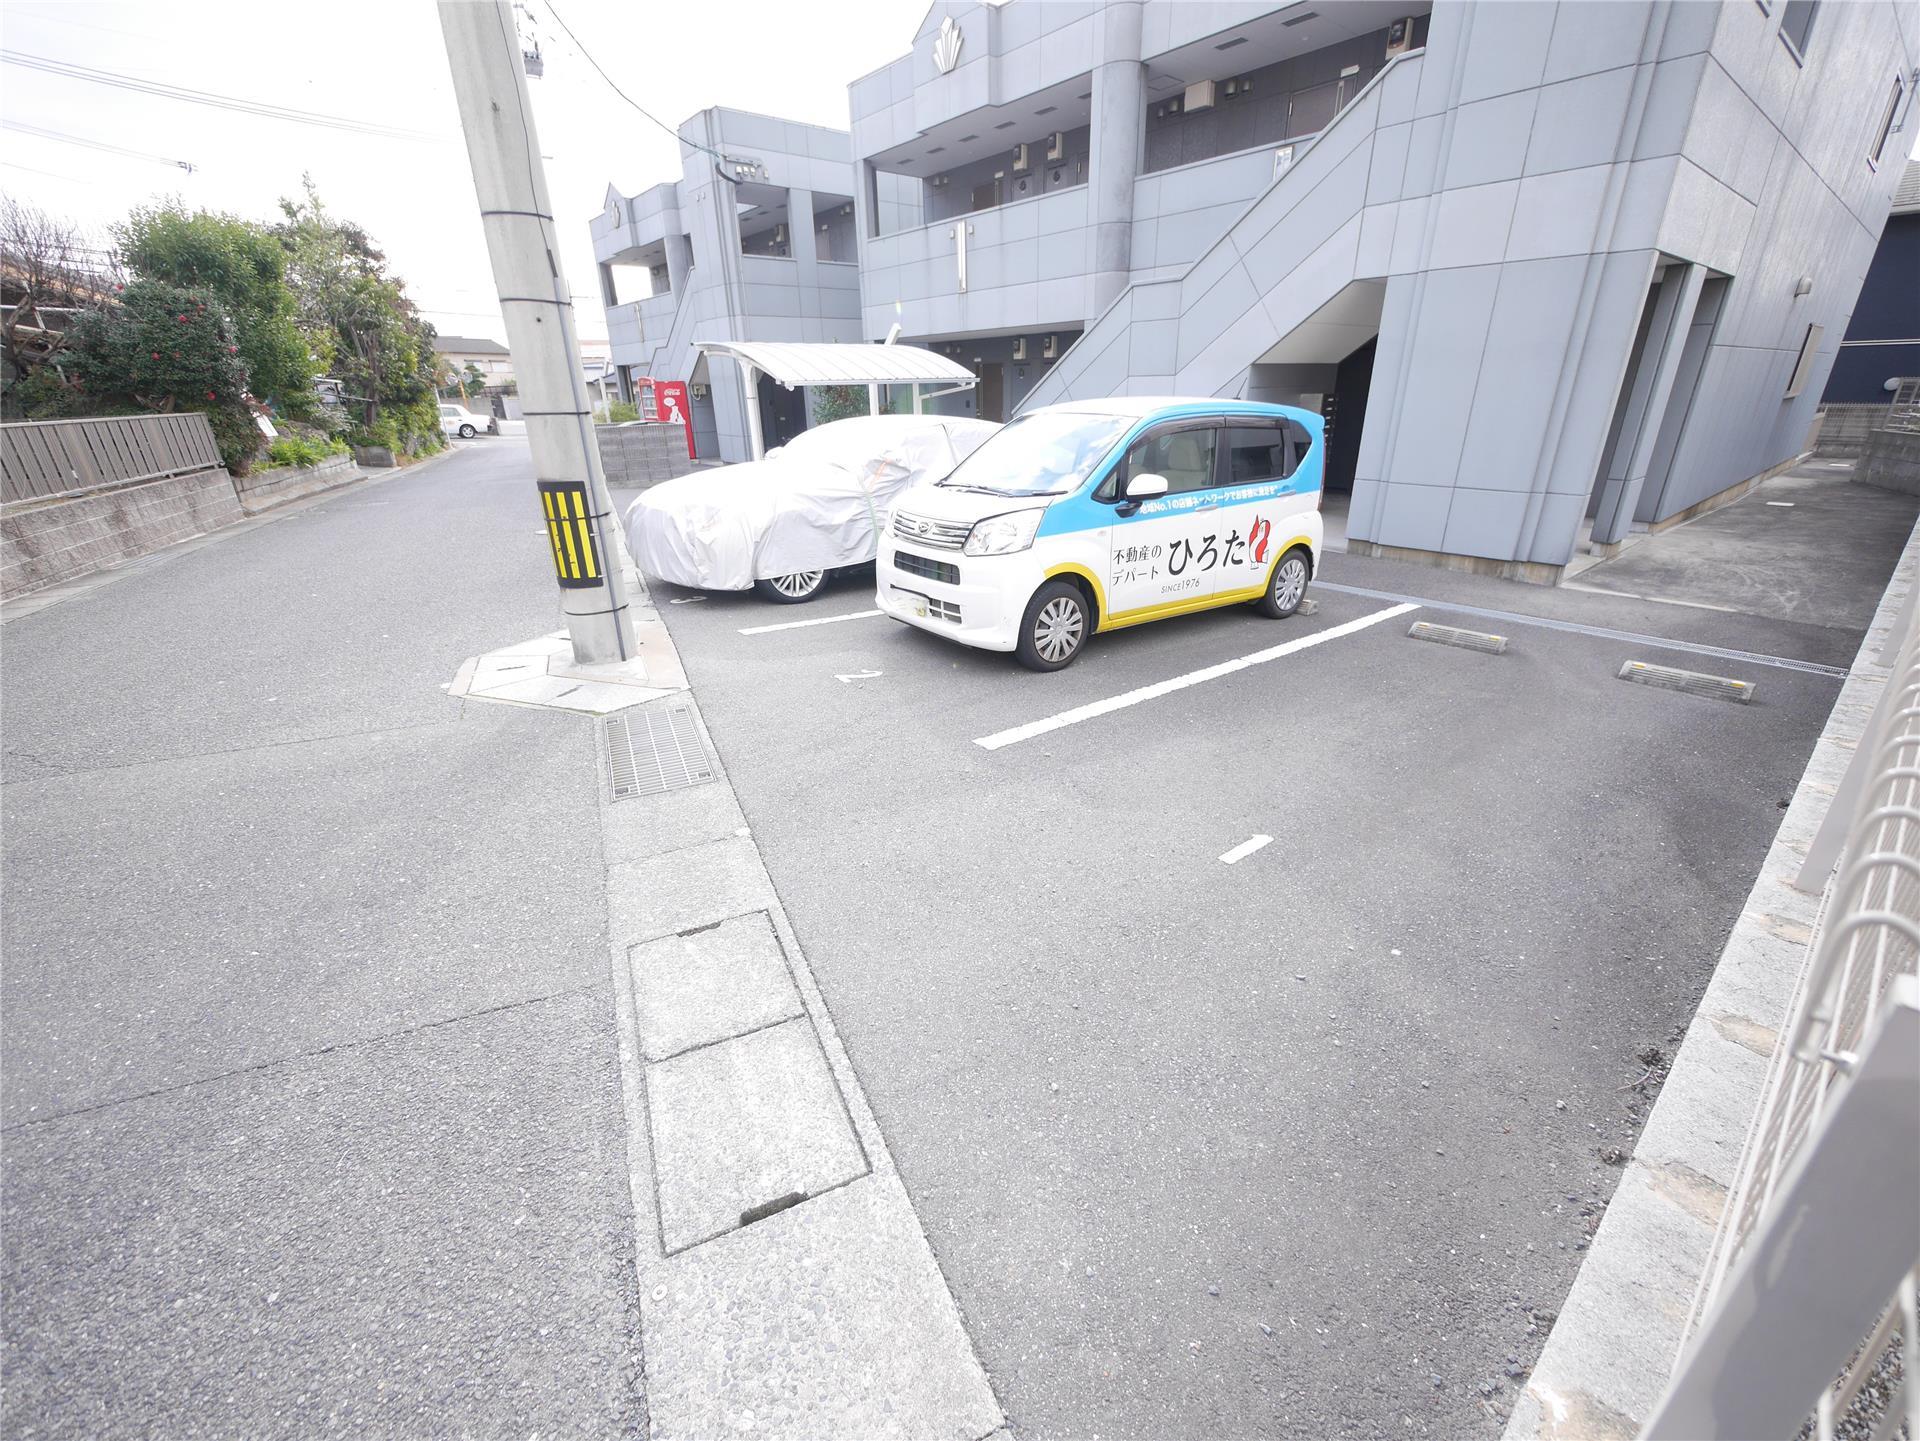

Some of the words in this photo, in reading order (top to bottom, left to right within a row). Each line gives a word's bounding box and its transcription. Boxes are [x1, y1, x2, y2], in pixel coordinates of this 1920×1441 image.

[1113, 545, 1162, 565] 不動産の
[1168, 529, 1246, 576] ひろた
[1113, 566, 1159, 586] デパート
